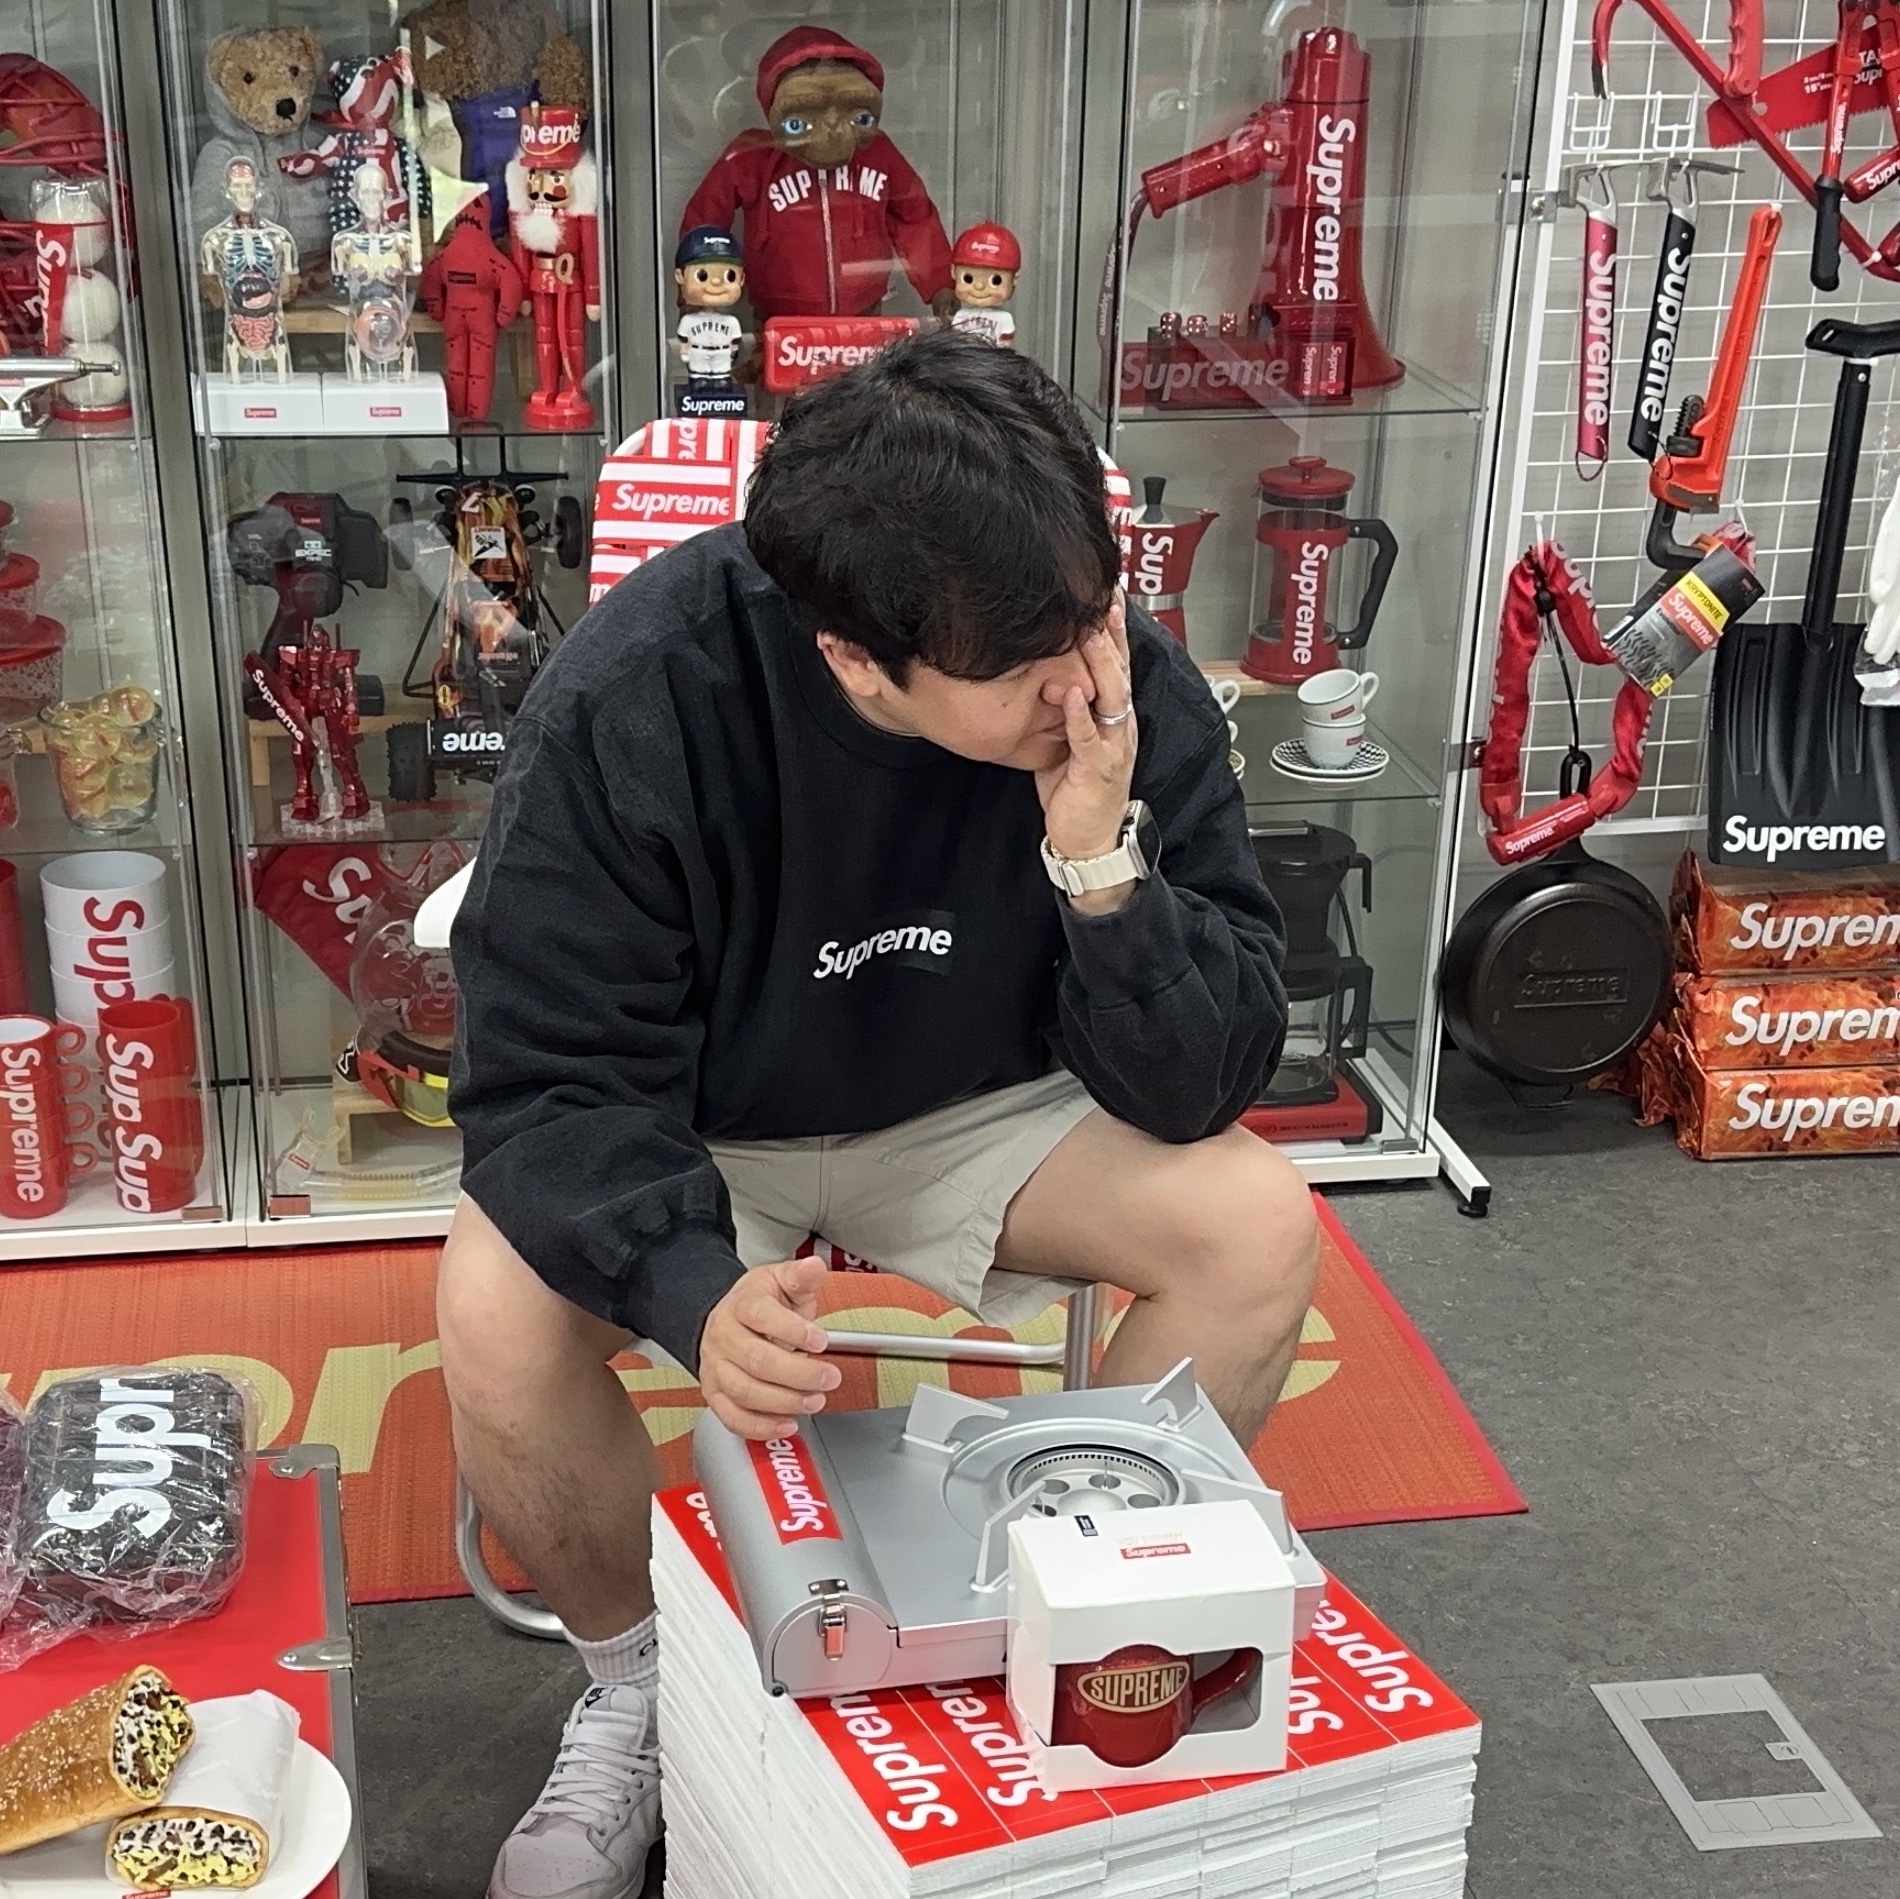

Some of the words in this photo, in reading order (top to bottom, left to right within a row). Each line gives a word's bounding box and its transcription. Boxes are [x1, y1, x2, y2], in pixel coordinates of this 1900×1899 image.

[767, 164, 888, 213] SUPRME
[1865, 160, 1900, 191] Supr
[1312, 114, 1356, 301] Supreme
[690, 321, 731, 337] SUPREME
[777, 336, 884, 376] Suprem
[1584, 251, 1617, 427] Supreme
[1641, 247, 1692, 424] Supreme
[1120, 350, 1291, 401] Supreme
[681, 396, 746, 417] Supreme
[1135, 532, 1174, 595] Sup
[1290, 541, 1329, 665] Supreme
[1668, 592, 1714, 646] Supreme
[1685, 579, 1724, 621] KRYPTONITE
[252, 669, 304, 743] Supreme
[443, 732, 506, 753] eme
[1504, 825, 1555, 856] Supreme
[1723, 815, 1887, 863] Supreme
[813, 924, 953, 981] Supreme
[1730, 902, 1900, 961] Suprem
[1724, 995, 1900, 1056] Suprem
[105, 1033, 154, 1123] Sup
[1, 1046, 45, 1203] Supreme
[1728, 1081, 1900, 1142] Suprem
[114, 1126, 163, 1213] Sup
[764, 1438, 828, 1533] Supreme
[1090, 1664, 1186, 1707] SUPREME
[1311, 1599, 1434, 1713] Supre
[830, 1694, 959, 1831] Suprem
